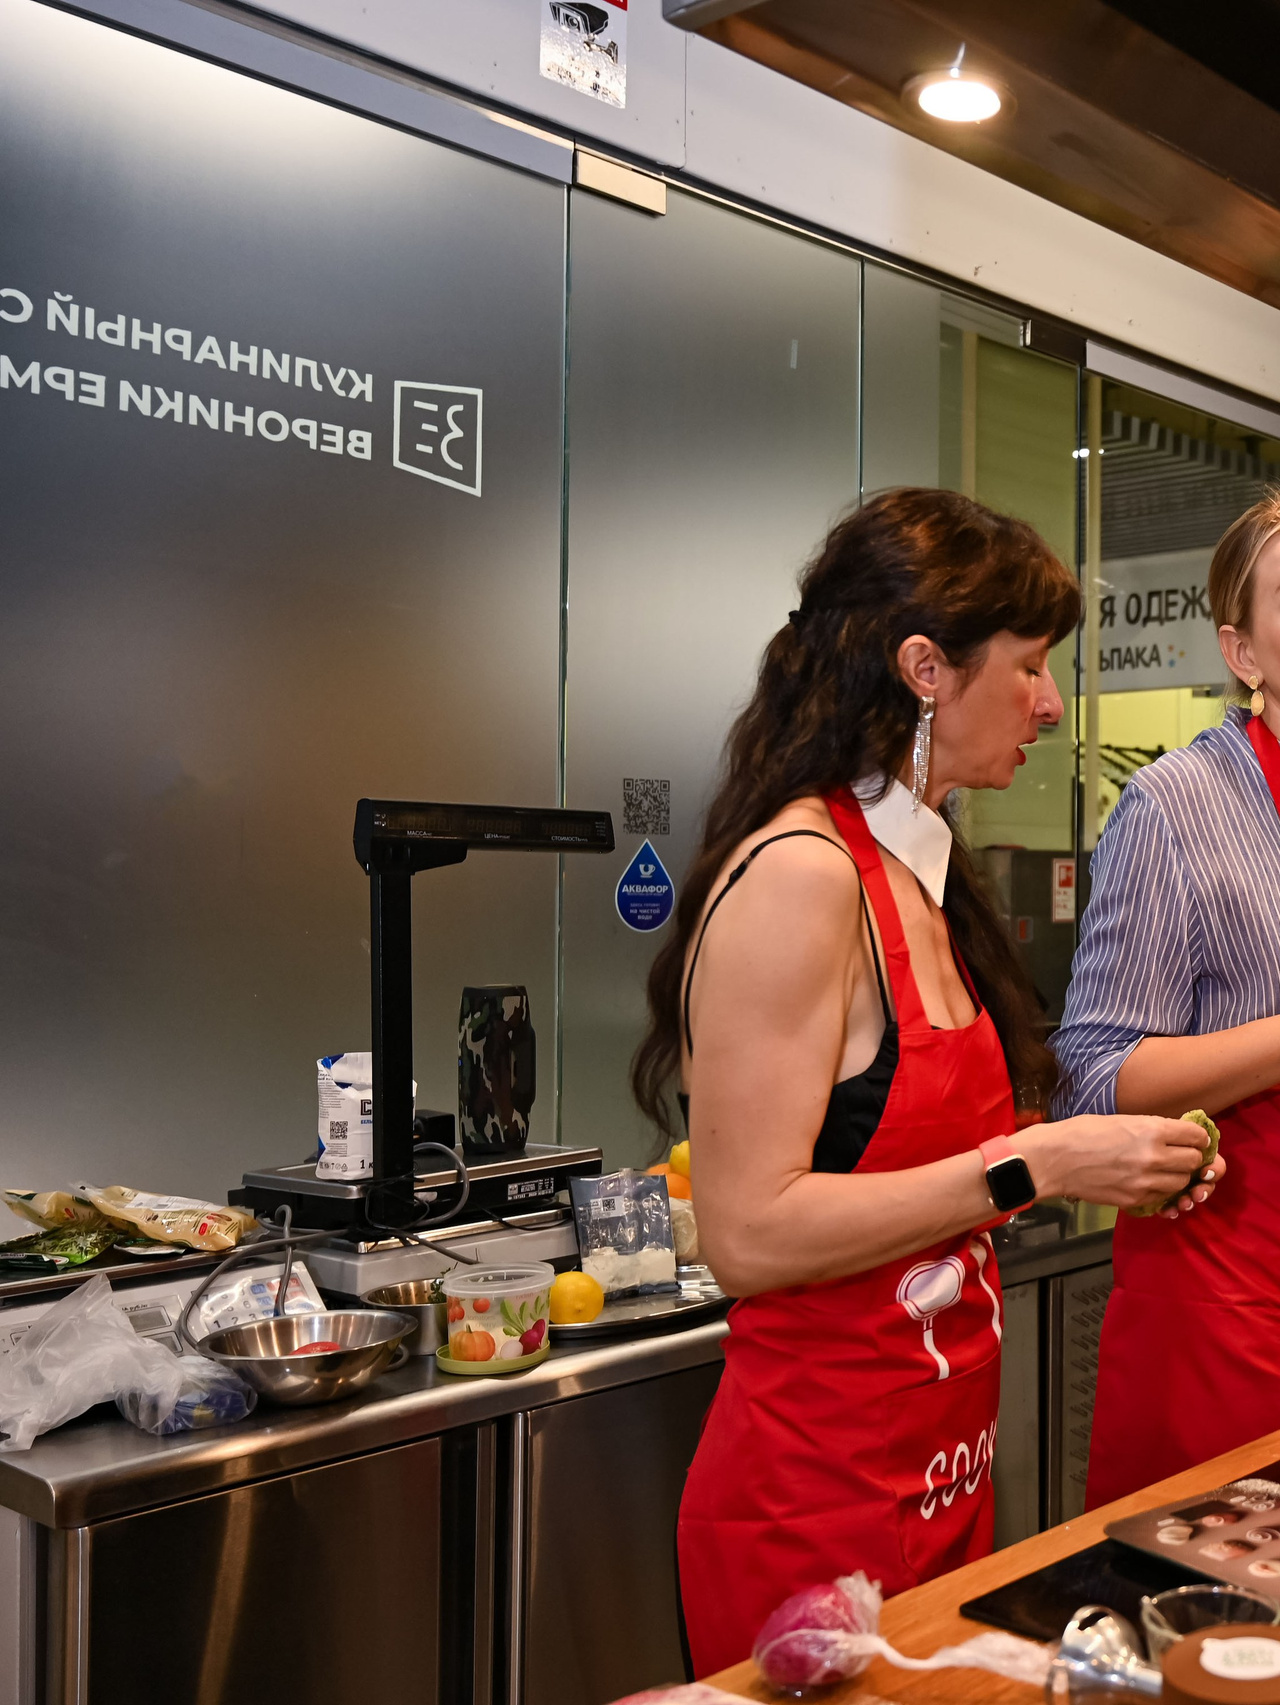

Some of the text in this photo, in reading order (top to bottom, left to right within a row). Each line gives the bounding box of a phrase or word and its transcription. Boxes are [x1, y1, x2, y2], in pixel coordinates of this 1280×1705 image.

[1125, 585, 1213, 628] ОДЕЖ
[1099, 643, 1162, 672] ЬПАКА
[621, 884, 669, 894] АКВАФОР
